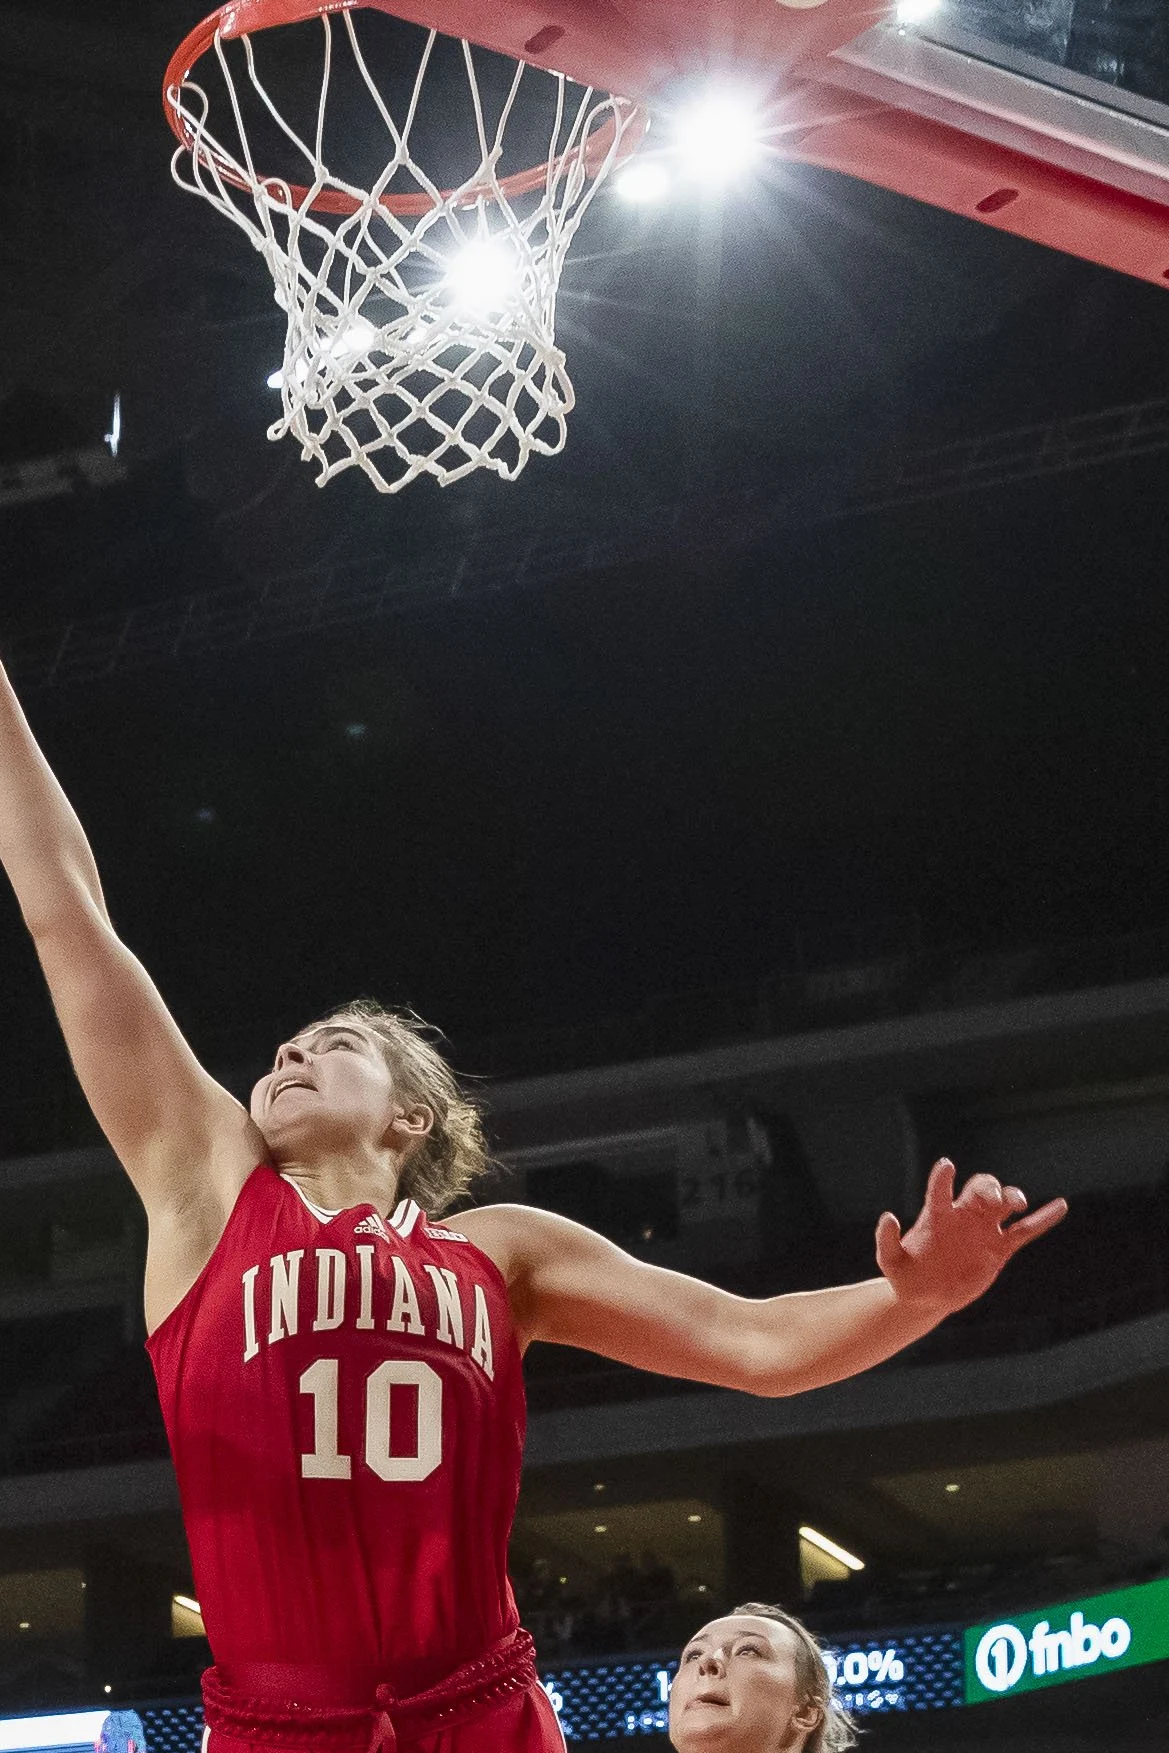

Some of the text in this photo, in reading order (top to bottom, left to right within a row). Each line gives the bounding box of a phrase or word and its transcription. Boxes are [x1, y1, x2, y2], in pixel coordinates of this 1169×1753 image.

[242, 1245, 494, 1383] INDIANA
[299, 1359, 443, 1482] 10
[1030, 1611, 1131, 1676] fnbo
